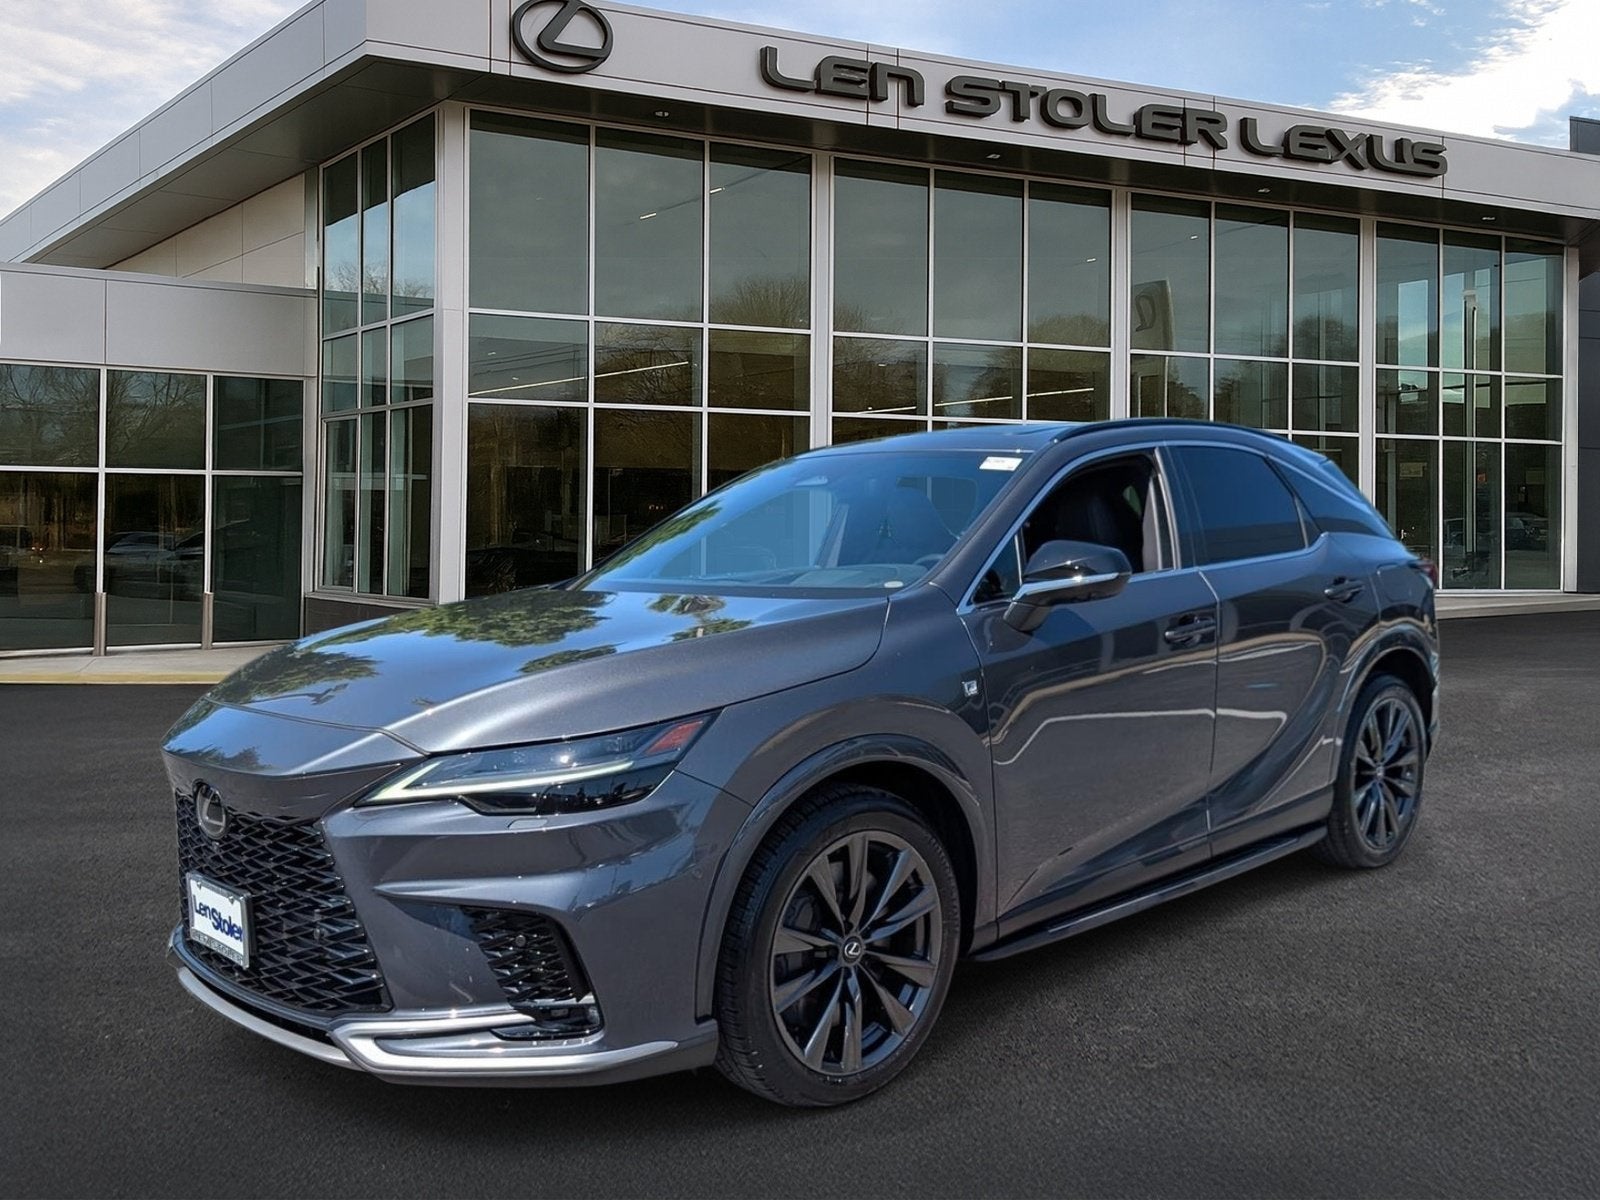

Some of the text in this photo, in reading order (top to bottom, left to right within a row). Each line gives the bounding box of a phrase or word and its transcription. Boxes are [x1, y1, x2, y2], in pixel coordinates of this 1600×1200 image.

[760, 45, 1448, 177] LEN STOLER LEXUS
